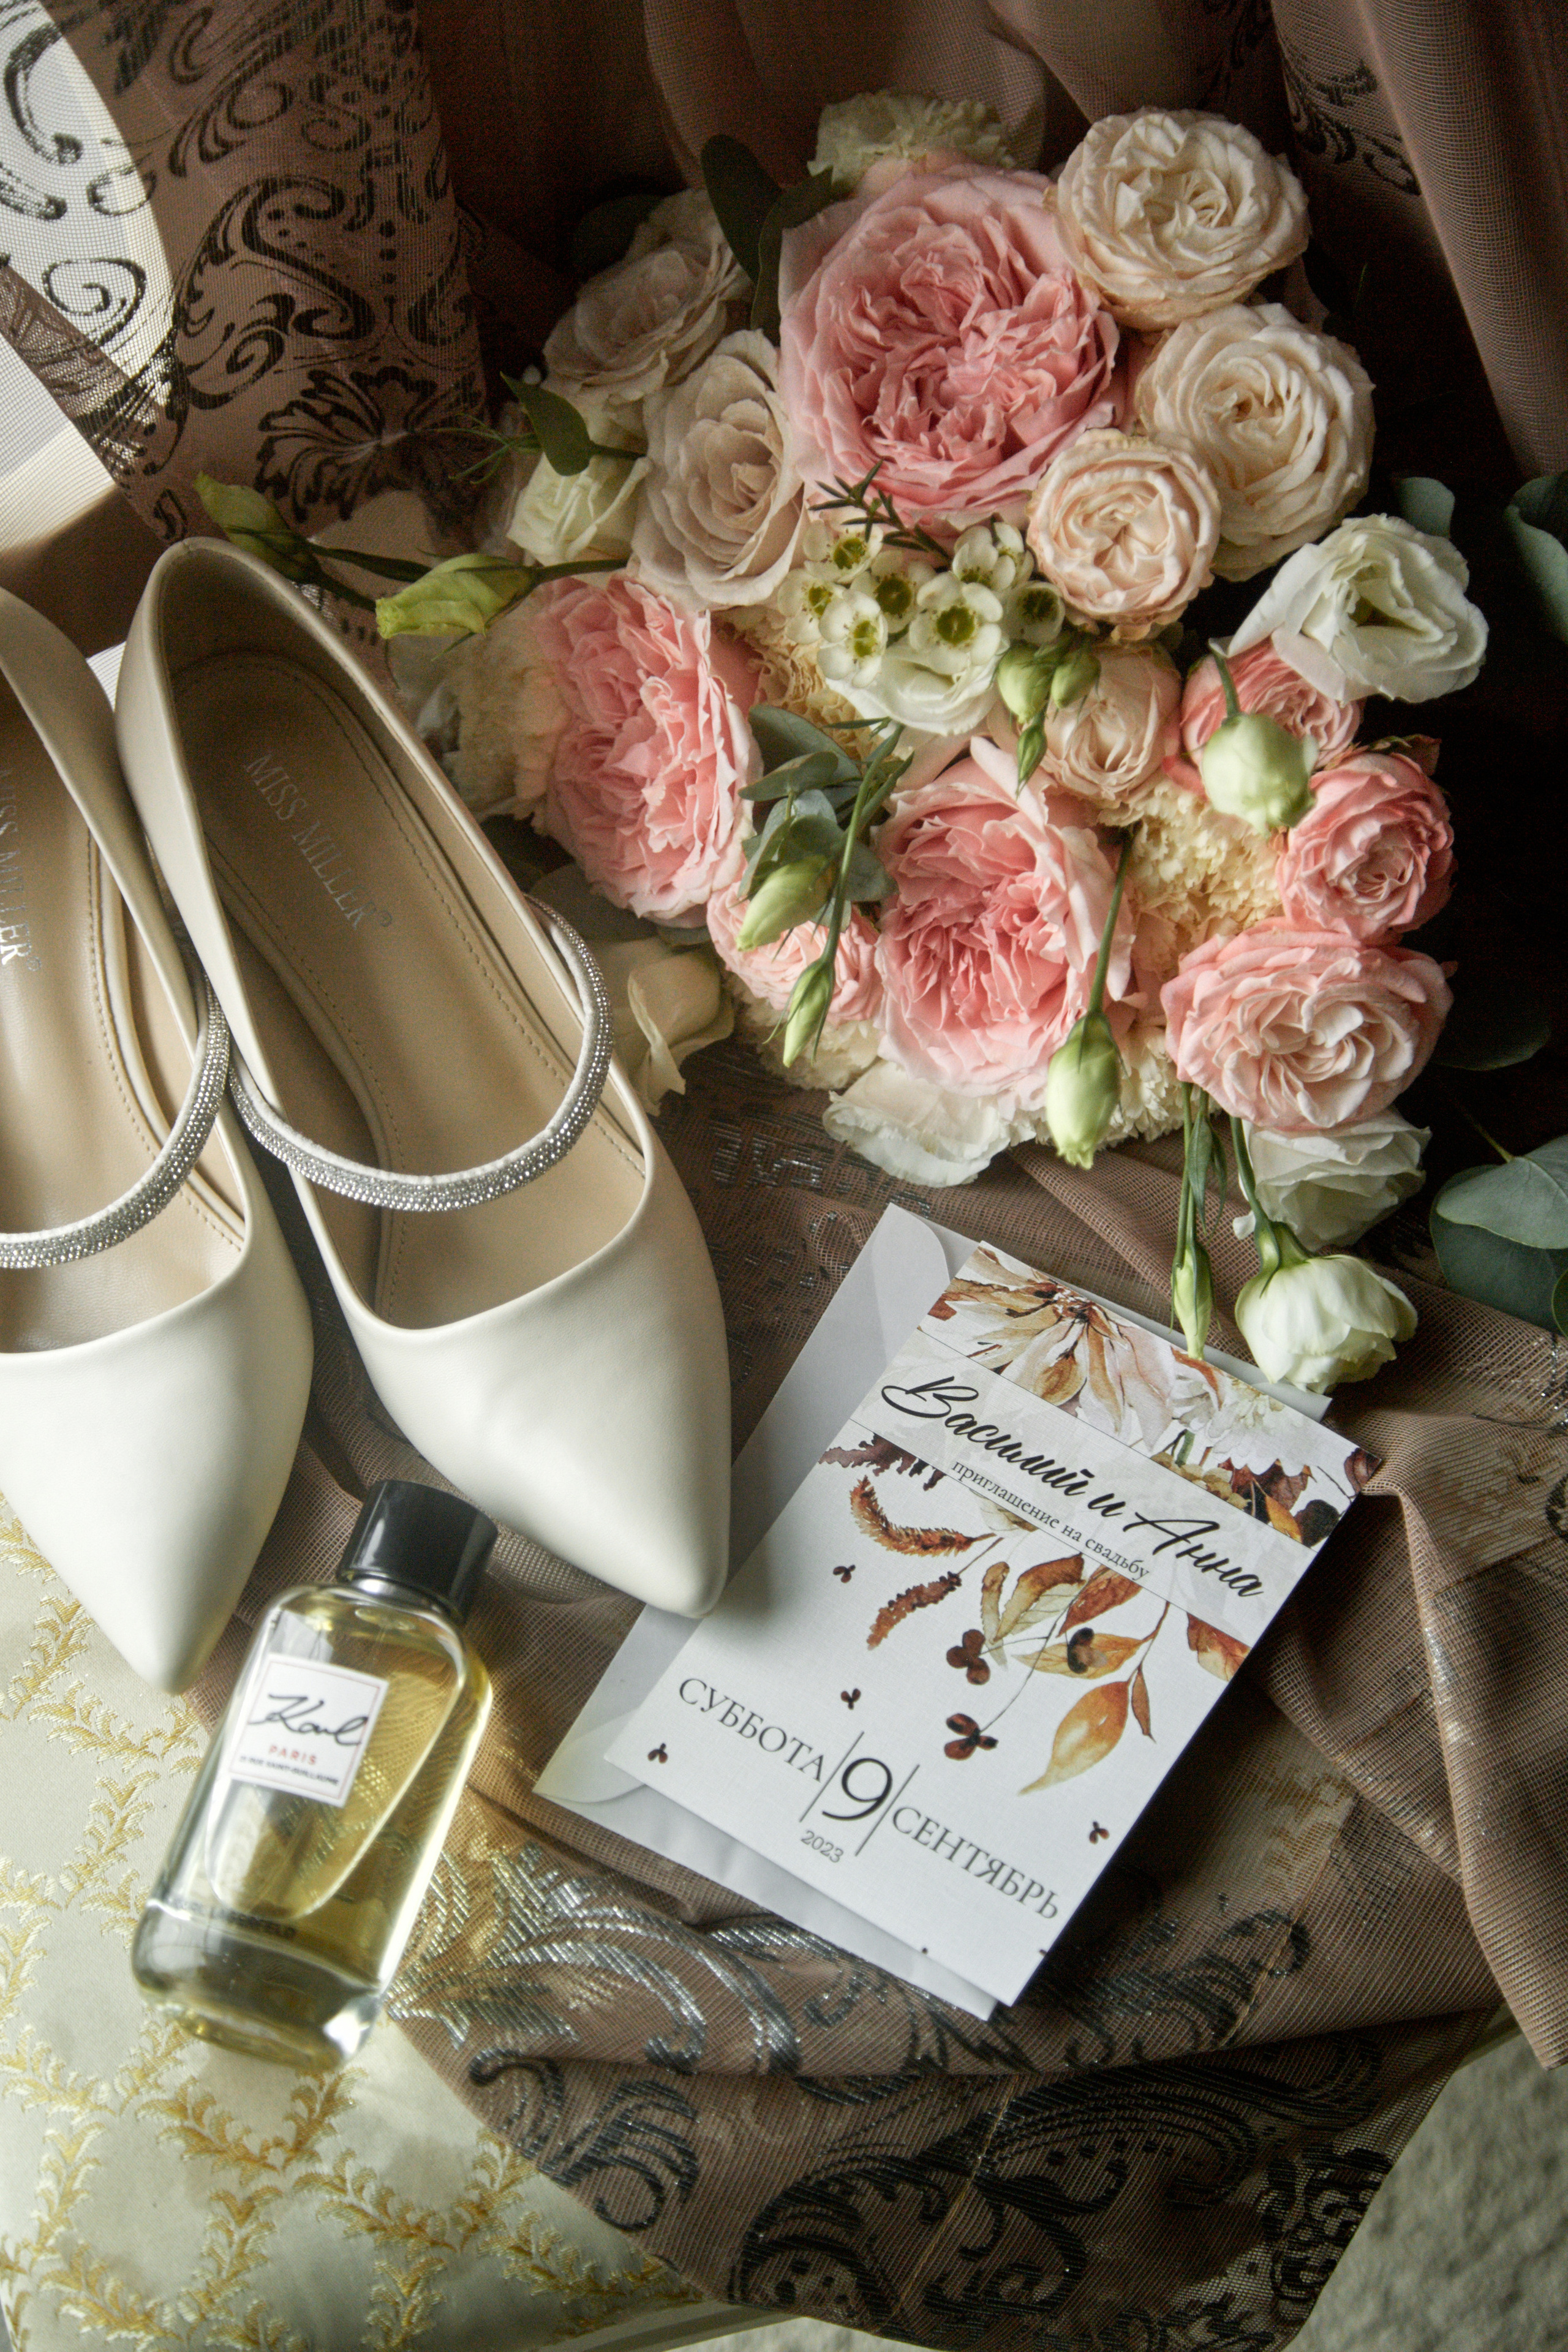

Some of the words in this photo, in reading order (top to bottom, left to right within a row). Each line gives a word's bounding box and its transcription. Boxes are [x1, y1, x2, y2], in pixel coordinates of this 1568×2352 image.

[244, 754, 309, 820] MISS
[881, 1376, 1095, 1496] Василий
[1087, 1493, 1126, 1517] и
[1122, 1511, 1264, 1597] Анна
[951, 1461, 1060, 1530] приглашение
[1060, 1524, 1082, 1542] на
[1085, 1538, 1150, 1581] свадьбу
[247, 1692, 369, 1746] Karl
[269, 1745, 317, 1765] PARIS
[679, 1678, 824, 1782] СУББОТА
[821, 1757, 893, 1822] 9
[892, 1806, 1058, 1920] СЕНТЯБРЬ
[800, 1830, 845, 1863] 2023
